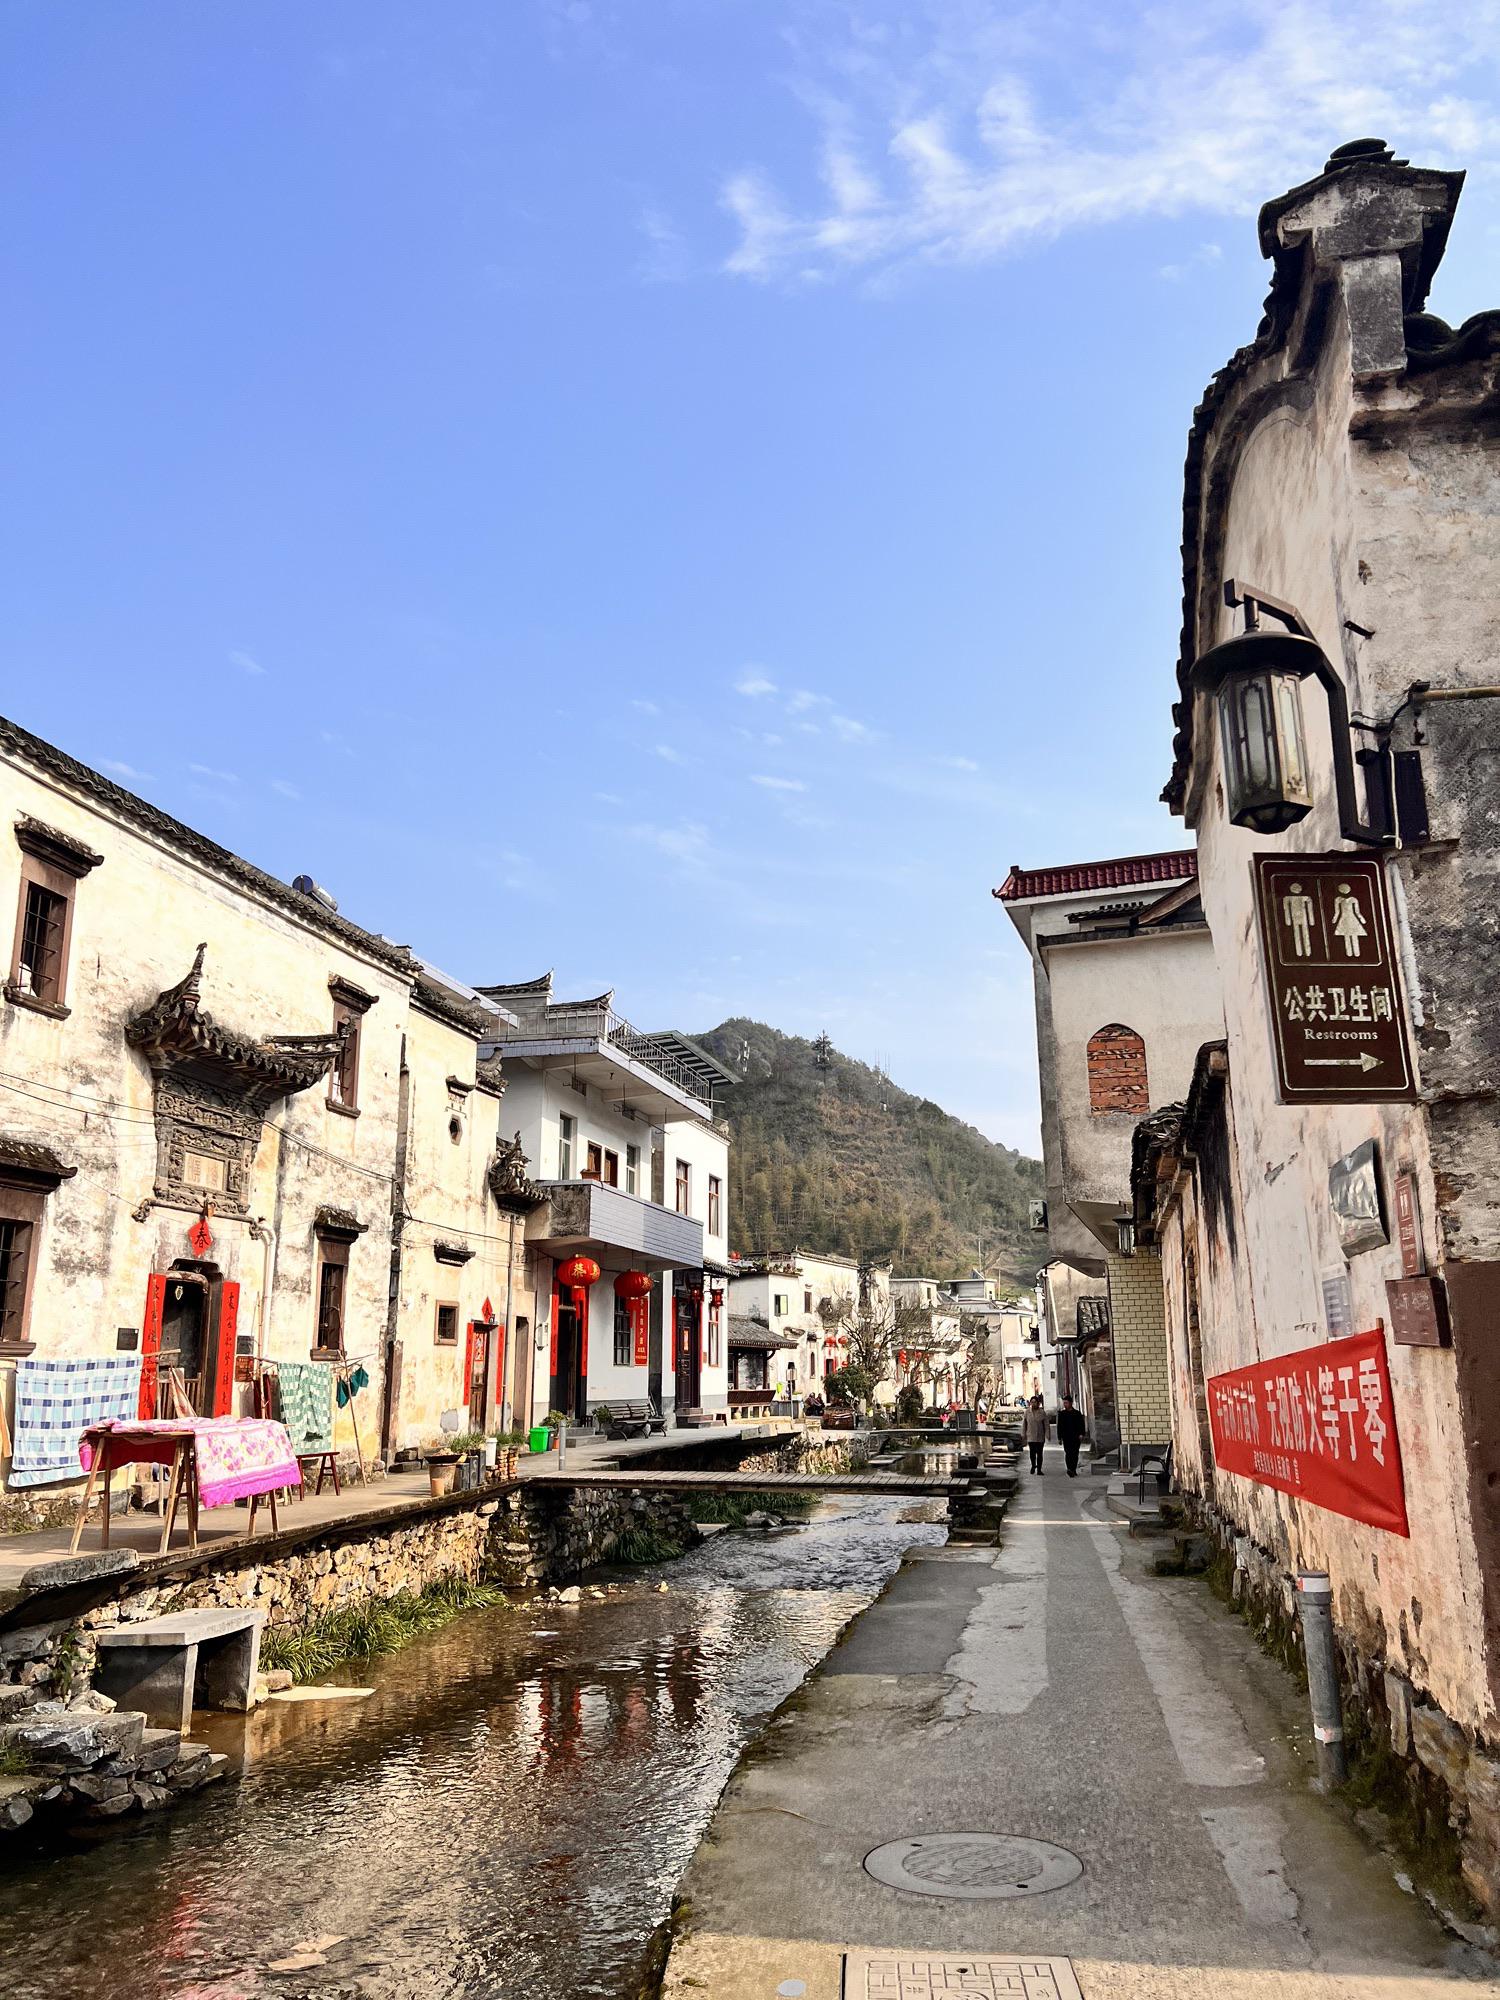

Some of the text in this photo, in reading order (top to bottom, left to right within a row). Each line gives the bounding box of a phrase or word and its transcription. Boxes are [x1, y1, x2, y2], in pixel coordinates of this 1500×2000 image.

[1283, 985, 1393, 1023] 公共卫生间
[1303, 1028, 1379, 1040] Restrooms
[194, 1225, 210, 1249] 春
[1264, 1357, 1387, 1467] 无视防火等于零
